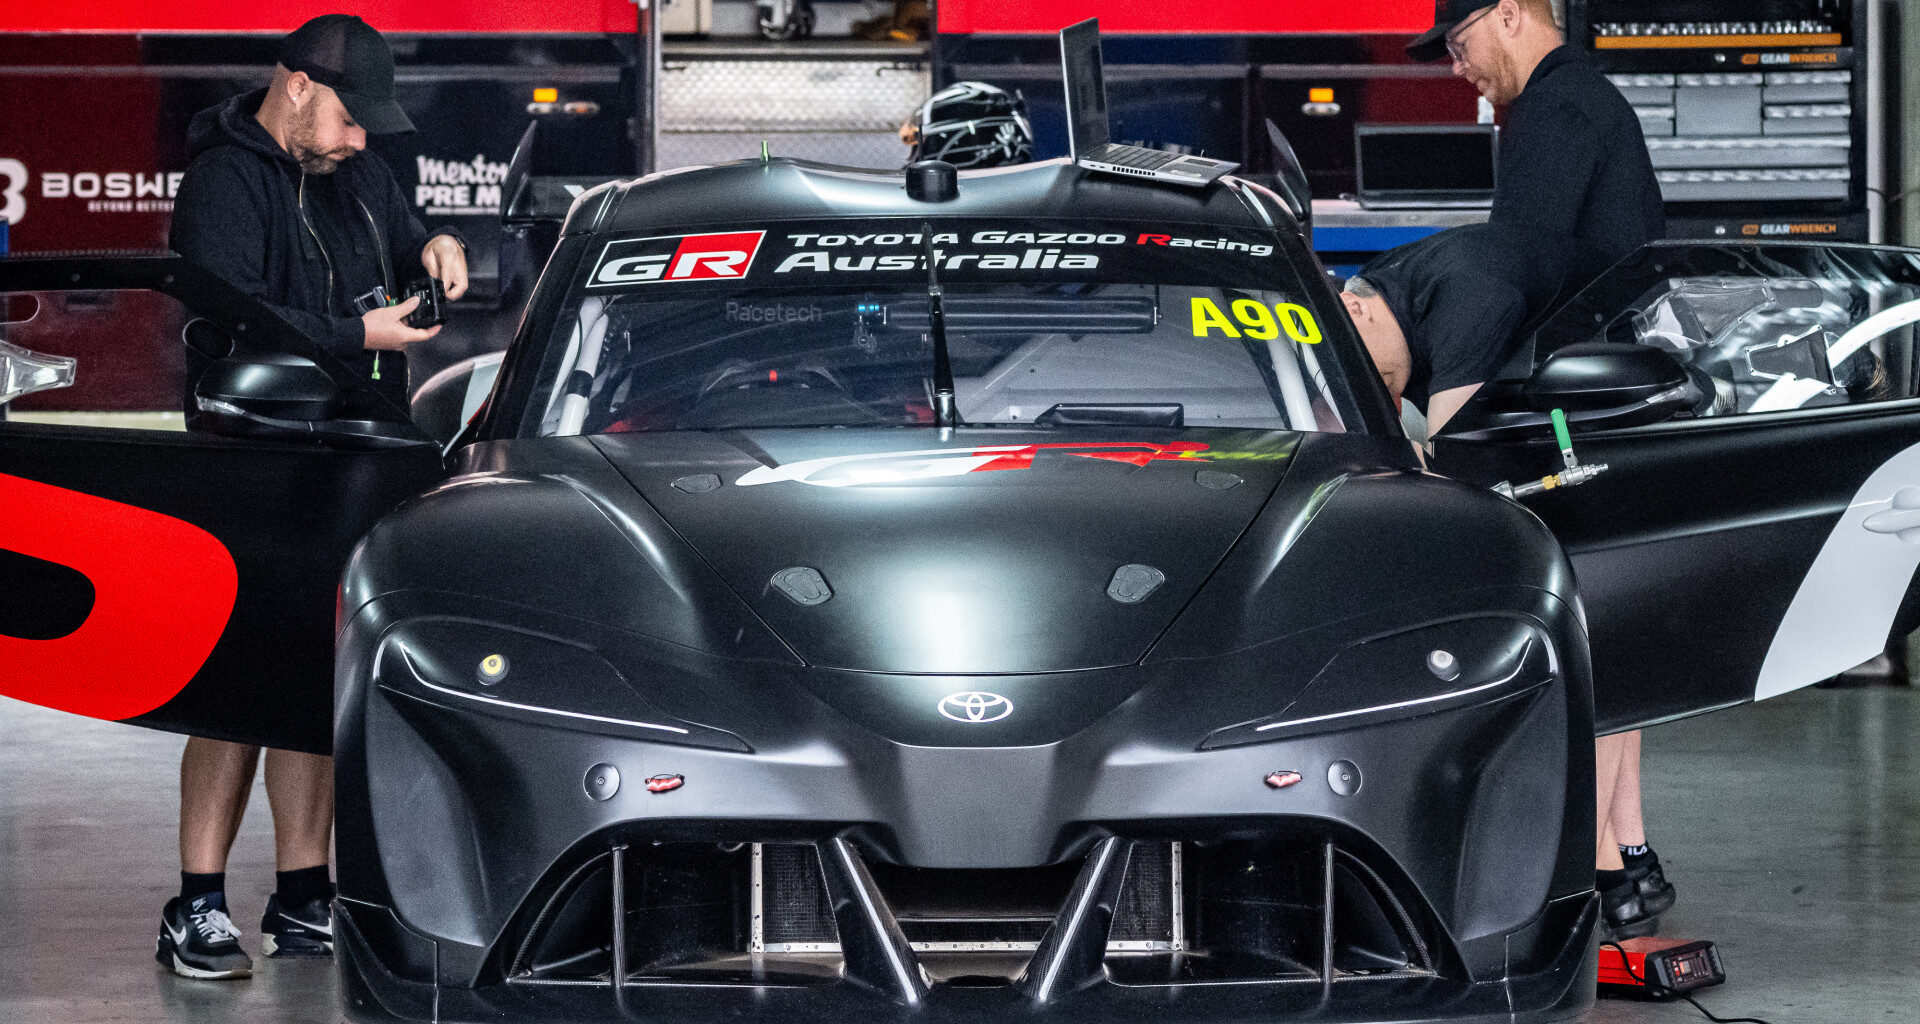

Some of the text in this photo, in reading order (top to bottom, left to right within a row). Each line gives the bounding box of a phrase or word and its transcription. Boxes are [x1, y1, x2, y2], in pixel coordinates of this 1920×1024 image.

[415, 185, 471, 207] PRE
[1760, 223, 1837, 235] GEARWRENCH
[787, 231, 1274, 257] TOYOTA GAZOO Racing
[598, 250, 748, 282] GR
[774, 249, 1099, 273] Australia
[726, 301, 822, 322] Racetech
[1191, 297, 1322, 345] A90
